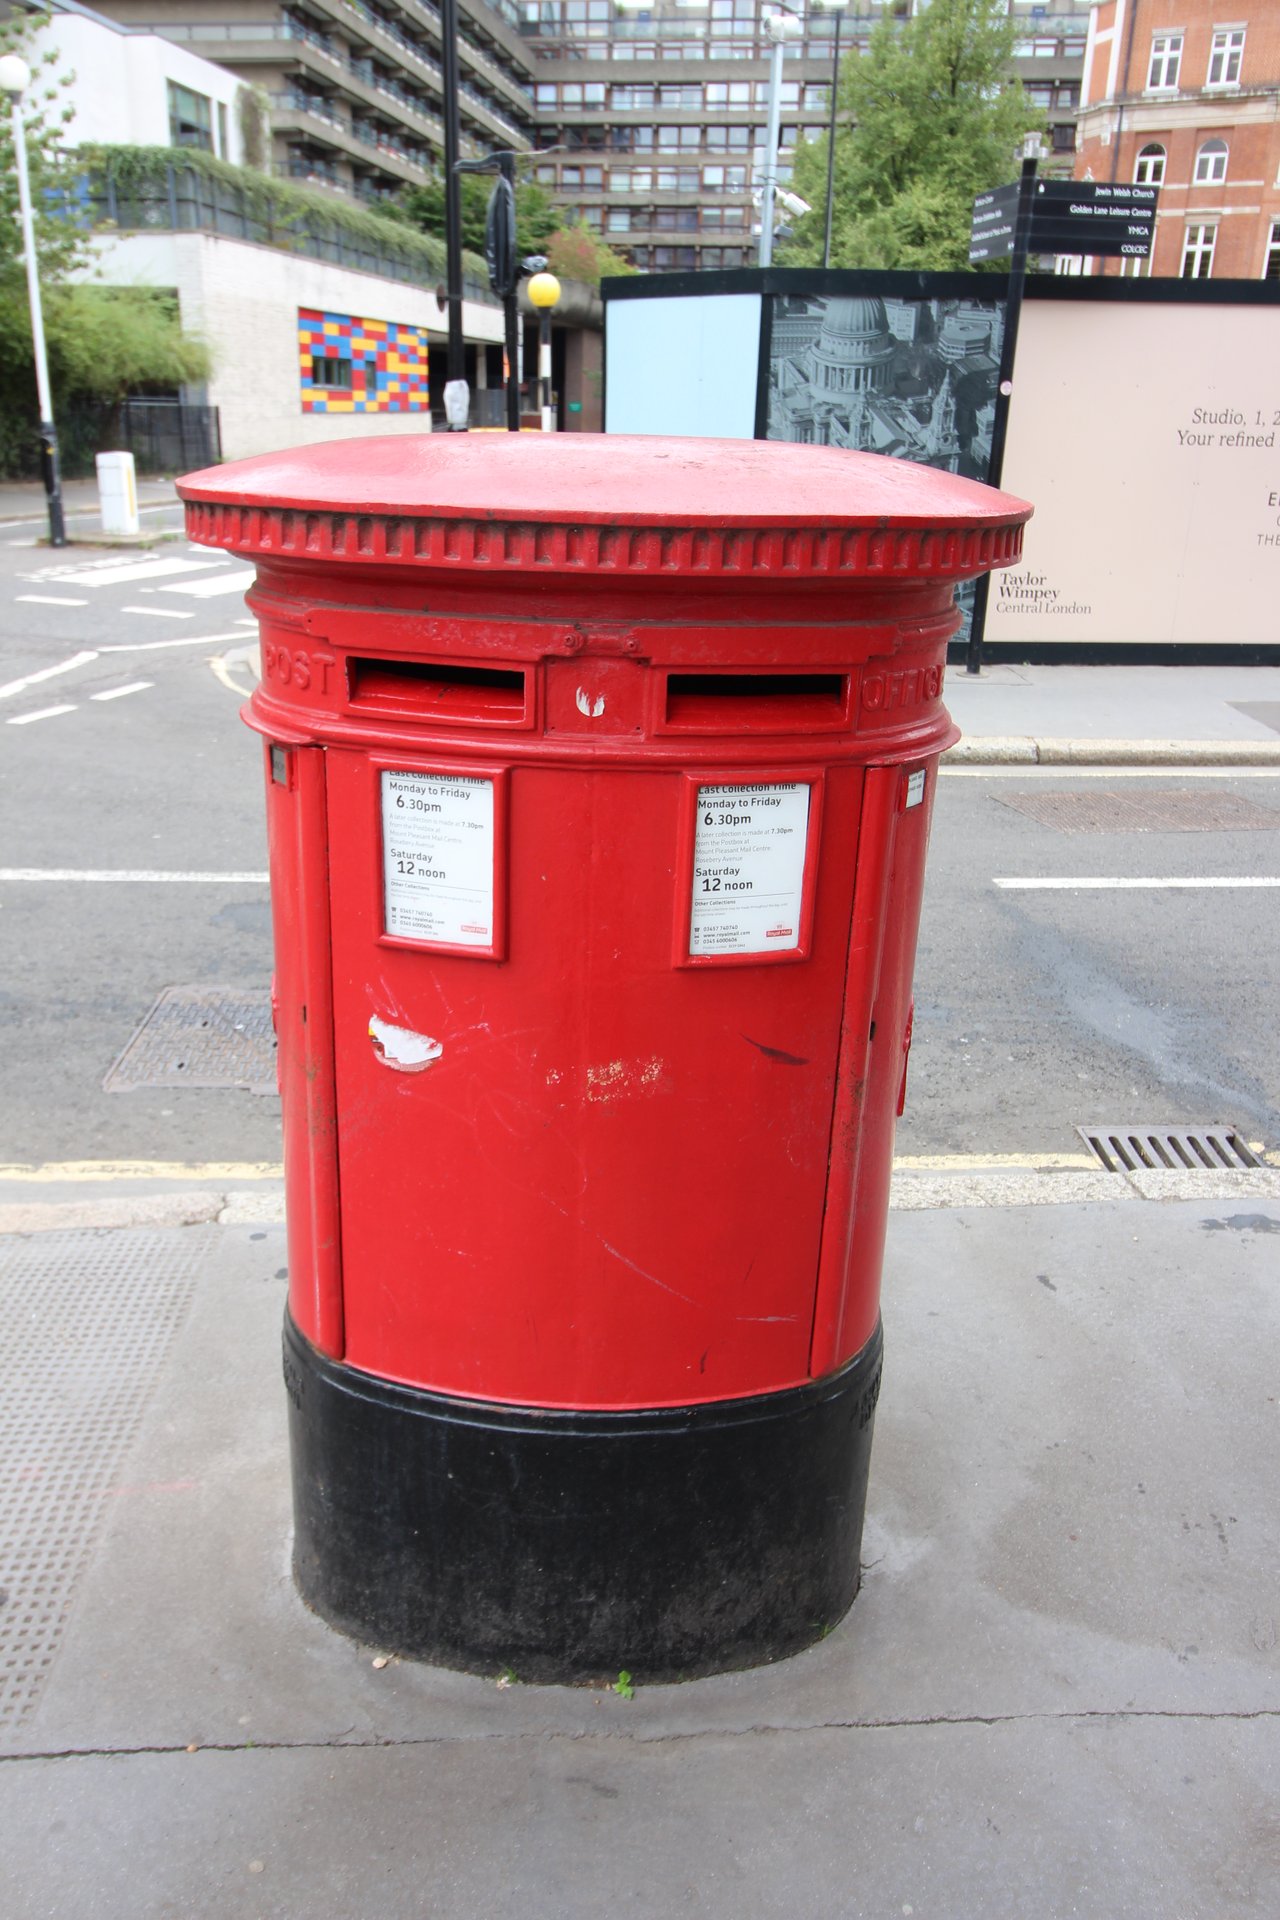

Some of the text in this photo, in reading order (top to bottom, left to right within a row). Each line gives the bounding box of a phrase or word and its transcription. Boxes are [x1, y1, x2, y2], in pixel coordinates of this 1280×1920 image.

[1113, 187, 1131, 198] Welsh
[1132, 188, 1155, 199] Church
[1069, 204, 1152, 218] Golden Lane Leisure Centre
[1128, 225, 1149, 236] YMCA
[1192, 408, 1247, 427] Studio,
[1255, 410, 1265, 427] 1,
[1177, 430, 1275, 448] Your refined
[1000, 572, 1047, 588] Taylor
[999, 586, 1060, 602] Wimpey
[996, 602, 1092, 615] Central London
[265, 643, 336, 695] POST
[389, 781, 471, 800] Monday to Friday
[698, 786, 720, 795] Last
[722, 785, 769, 794] Collection
[396, 795, 442, 813] 6.30pm
[698, 797, 781, 809] Monday to Friday
[704, 812, 751, 826] 6.30pm
[771, 827, 793, 835] 7.30pm
[390, 848, 433, 863] Saturday
[397, 860, 446, 879] 12 noon
[695, 867, 740, 877] Saturday
[702, 878, 753, 892] 12 noon
